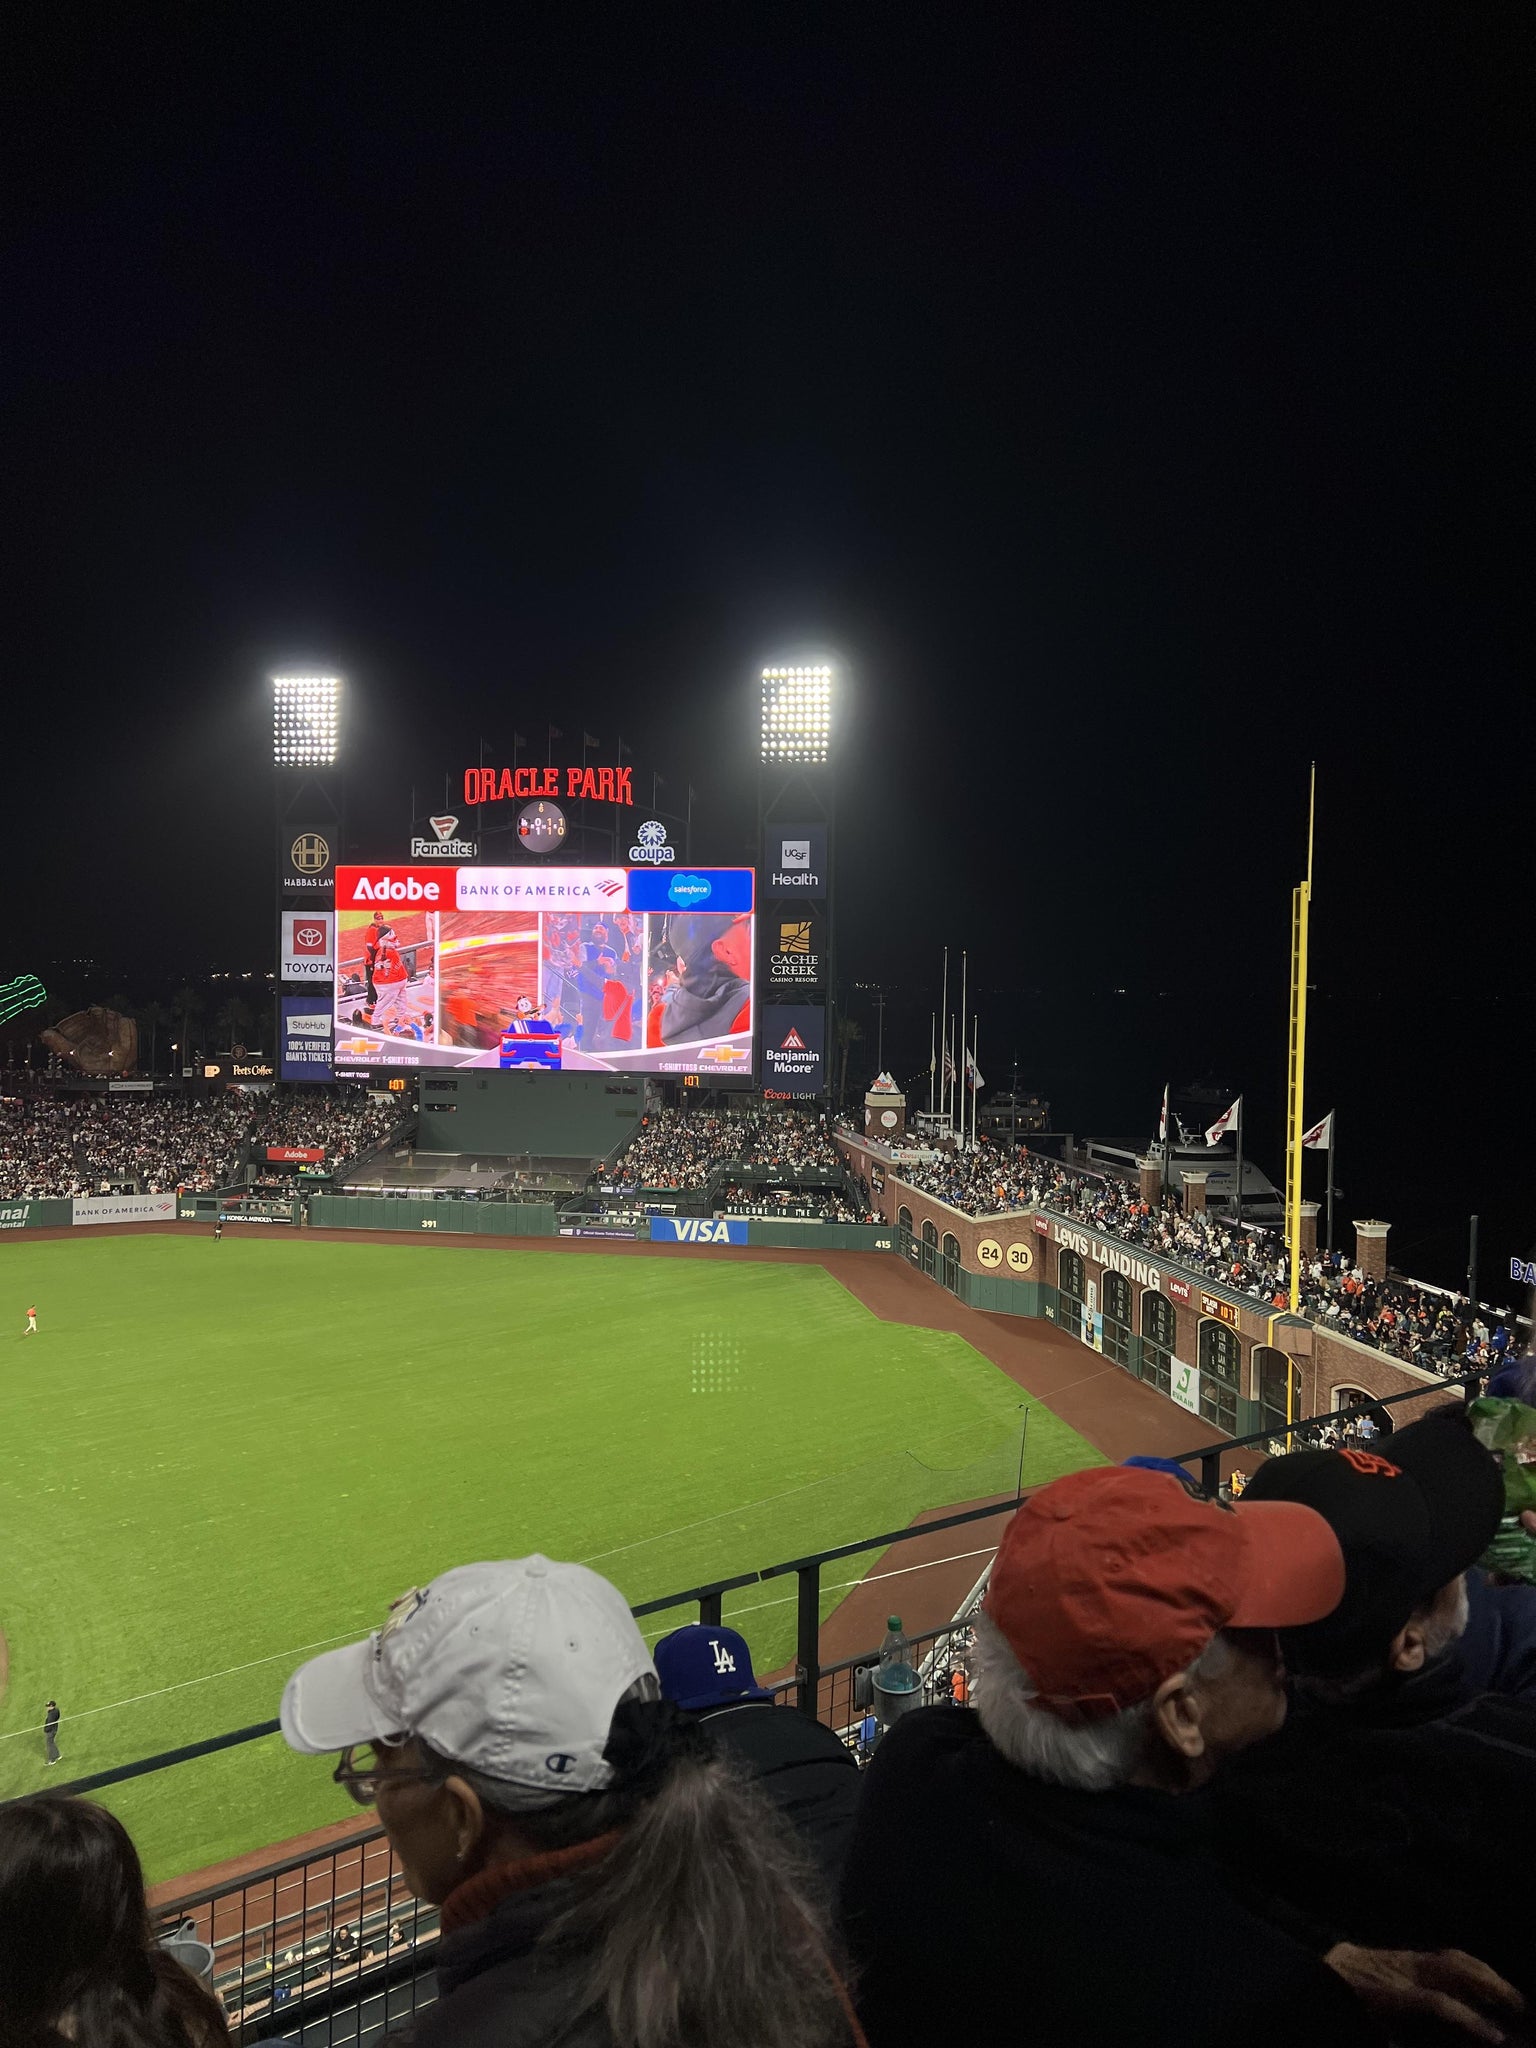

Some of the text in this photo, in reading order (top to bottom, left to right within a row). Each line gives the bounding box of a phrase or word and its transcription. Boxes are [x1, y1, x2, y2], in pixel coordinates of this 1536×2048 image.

[465, 767, 633, 805] ORACLE PARK
[535, 818, 541, 826] 0
[547, 818, 552, 826] 1
[558, 818, 563, 826] 1
[536, 827, 540, 835] 1
[547, 827, 552, 835] 1
[557, 827, 564, 835] 0
[412, 840, 474, 856] Fanatics
[631, 847, 673, 863] coupa
[784, 849, 807, 860] UCSF
[284, 878, 317, 887] HABBAS
[772, 873, 818, 885] Health
[352, 877, 440, 900] Adobe
[460, 885, 591, 896] BANK OF AMERICA
[674, 884, 708, 894] salesforce
[770, 955, 818, 965] CACHE
[285, 963, 334, 974] TOYOTA
[772, 966, 817, 975] CREEK
[292, 1020, 325, 1029] StubHub
[288, 1041, 331, 1051] 100% VERIFIED
[286, 1052, 332, 1062] GIANTS TICKETS
[382, 1056, 403, 1064] T-SHIRT
[404, 1056, 419, 1064] TOSS
[766, 1050, 819, 1062] Benjamin
[233, 1065, 251, 1076] Peet's
[252, 1065, 273, 1077] Coffee
[659, 1063, 684, 1071] T-SHIRT
[684, 1063, 697, 1072] TOSS
[774, 1063, 812, 1073] Moore
[764, 1088, 791, 1099] Coors
[284, 1151, 308, 1159] Adobe
[75, 1208, 99, 1216] BANK
[115, 1206, 154, 1214] AMERICA
[180, 1210, 196, 1218] 399
[727, 1206, 768, 1215] WELCOME
[777, 1207, 787, 1216] TO
[795, 1208, 811, 1217] THE
[421, 1220, 437, 1228] 391
[669, 1219, 730, 1243] VISA
[875, 1240, 891, 1249] 415
[982, 1247, 999, 1261] 24
[1011, 1250, 1028, 1265] 30
[1092, 1241, 1161, 1292] LANDING
[1511, 1257, 1536, 1285] BA
[1202, 1296, 1218, 1310] SPLASH
[1183, 1396, 1194, 1409] AIR
[709, 1641, 736, 1674] LA
